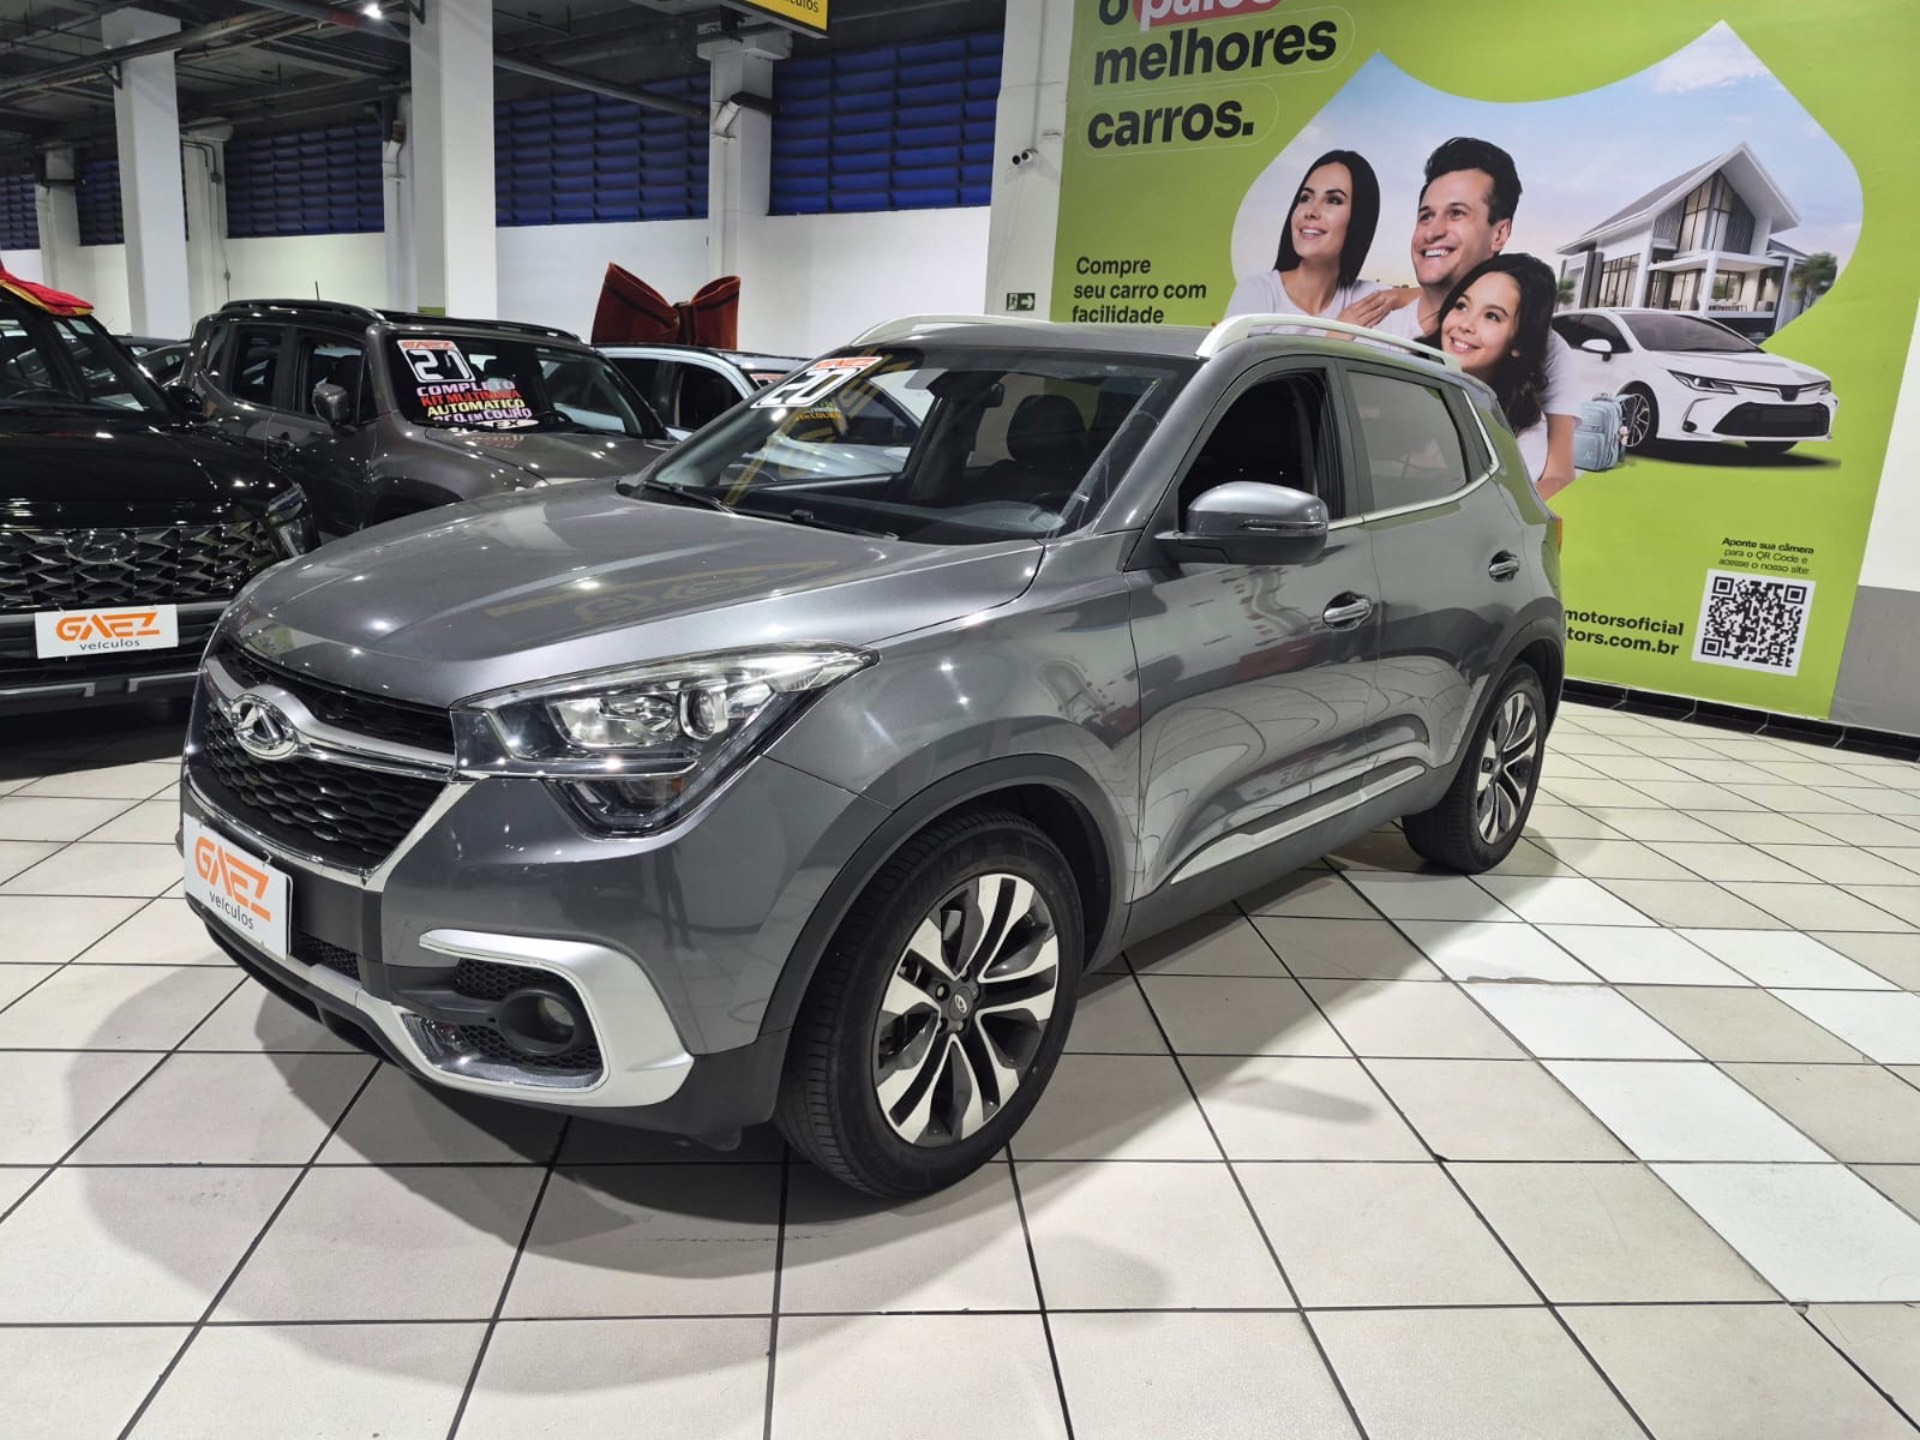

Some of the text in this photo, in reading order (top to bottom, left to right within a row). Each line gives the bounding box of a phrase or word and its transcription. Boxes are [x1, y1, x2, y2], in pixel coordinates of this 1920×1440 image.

[1094, 20, 1337, 86] melhores
[1087, 100, 1254, 149] carros.
[1076, 256, 1151, 279] Compre
[1073, 283, 1207, 299] seu carro com
[1072, 304, 1164, 324] facilidade
[408, 349, 470, 380] 21
[421, 394, 444, 407] KIT
[483, 408, 533, 420] COURO
[1721, 537, 1814, 554] Aponte sua câmera
[1724, 548, 1744, 558] para
[1755, 551, 1770, 560] QR
[1772, 552, 1799, 563] Code
[1760, 563, 1789, 572] nosso
[55, 612, 161, 642] GAEZ
[194, 836, 272, 922] GAEZ
